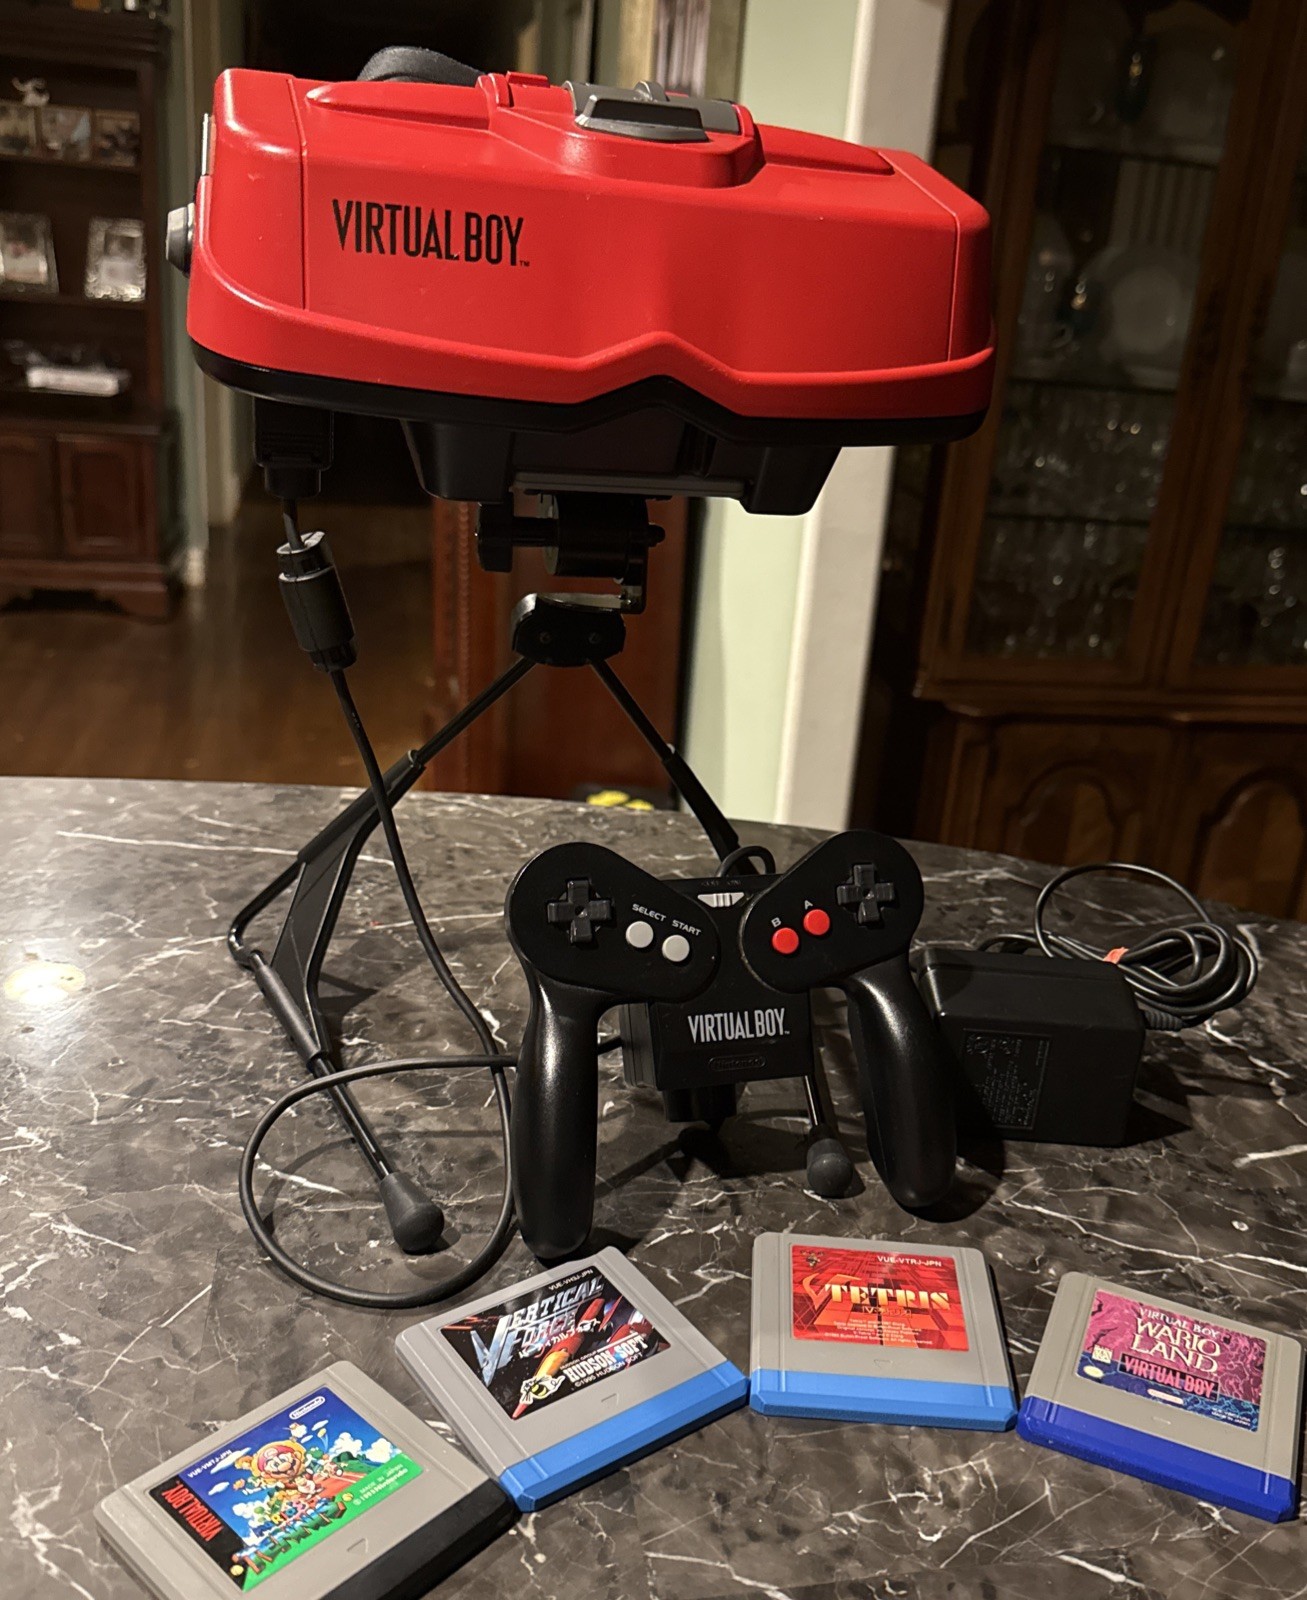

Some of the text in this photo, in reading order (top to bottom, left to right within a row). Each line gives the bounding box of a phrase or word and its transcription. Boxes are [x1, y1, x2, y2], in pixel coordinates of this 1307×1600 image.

[632, 903, 701, 937] SELECT START
[771, 917, 781, 928] B
[804, 900, 813, 910] A
[877, 1255, 943, 1267] VUE-VTRJ-JPN
[824, 1283, 950, 1310] TETRIS
[469, 1275, 605, 1388] VERTICAL
[497, 1308, 577, 1370] FORCE
[1135, 1317, 1221, 1357] WARIO
[1139, 1307, 1221, 1338] VIRTUAL BOY
[563, 1334, 648, 1383] HUDSON SOFT
[596, 1361, 625, 1378] HUDSON
[625, 1352, 643, 1365] SOFT
[1130, 1333, 1218, 1373] LAND
[1124, 1355, 1182, 1391] VIRTUAL
[1184, 1375, 1214, 1399] BOY
[232, 1496, 347, 1575] TENNIS
